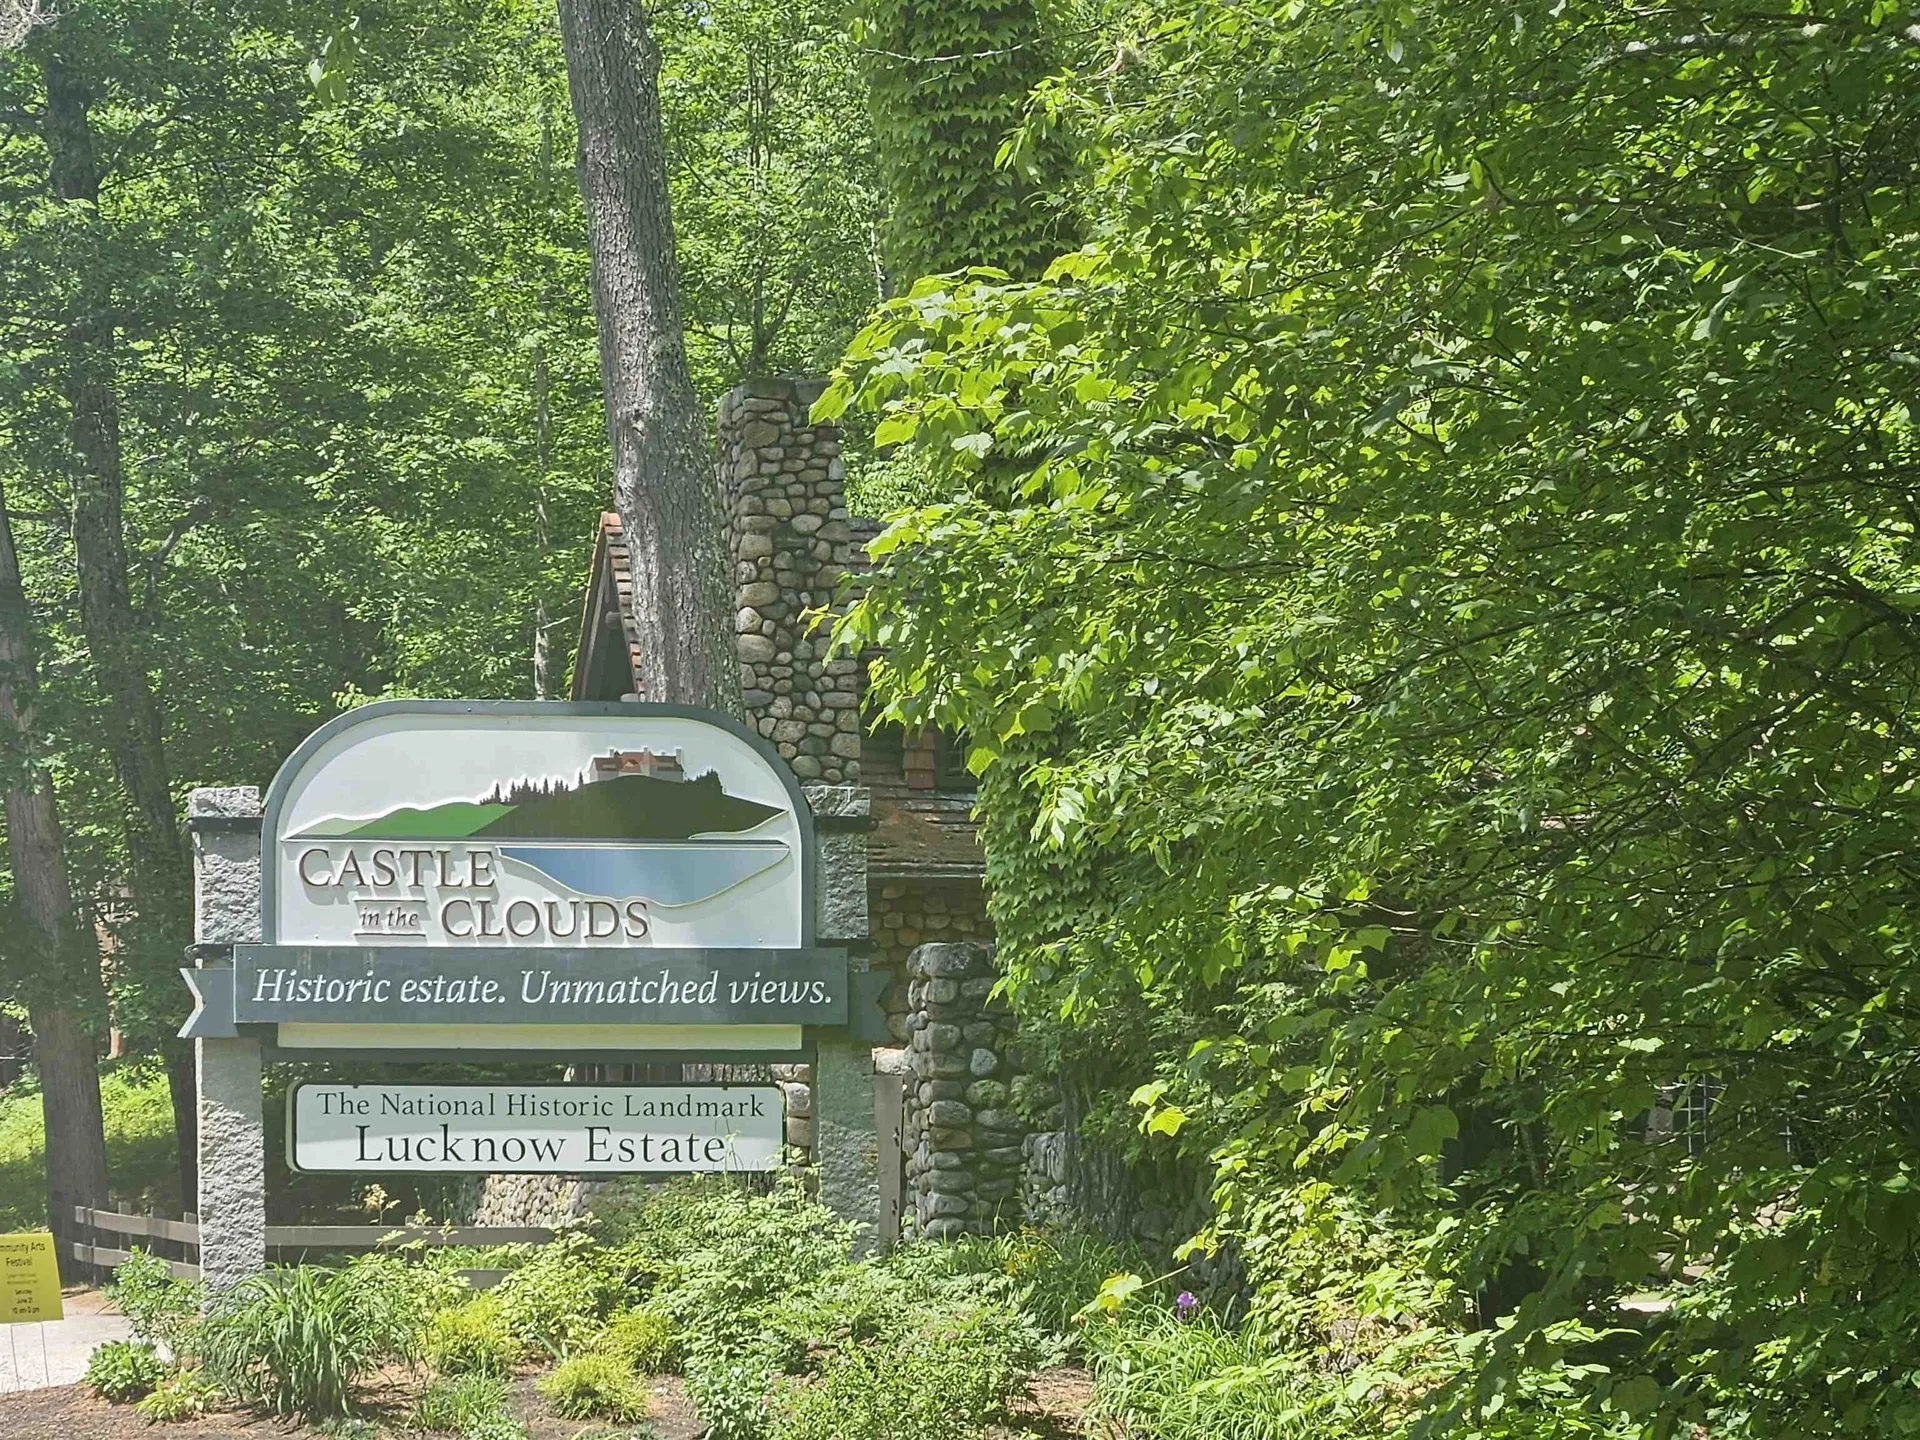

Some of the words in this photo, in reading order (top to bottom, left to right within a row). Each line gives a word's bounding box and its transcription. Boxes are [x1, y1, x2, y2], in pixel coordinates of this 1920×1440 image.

[299, 848, 495, 888] CASTLE
[360, 908, 382, 929] in
[386, 905, 419, 929] the
[441, 900, 649, 939] CLOUDS
[252, 968, 392, 1004] Historic
[400, 974, 507, 1004] estate.
[520, 969, 718, 1005] Unmatched
[727, 971, 833, 1004] views.
[317, 1092, 370, 1117] The
[379, 1092, 495, 1117] National
[506, 1092, 614, 1117] Historic
[624, 1092, 765, 1119] Landmark
[355, 1125, 566, 1163] Lucknow
[584, 1127, 727, 1163] Estate
[5, 1257, 33, 1267] Festival
